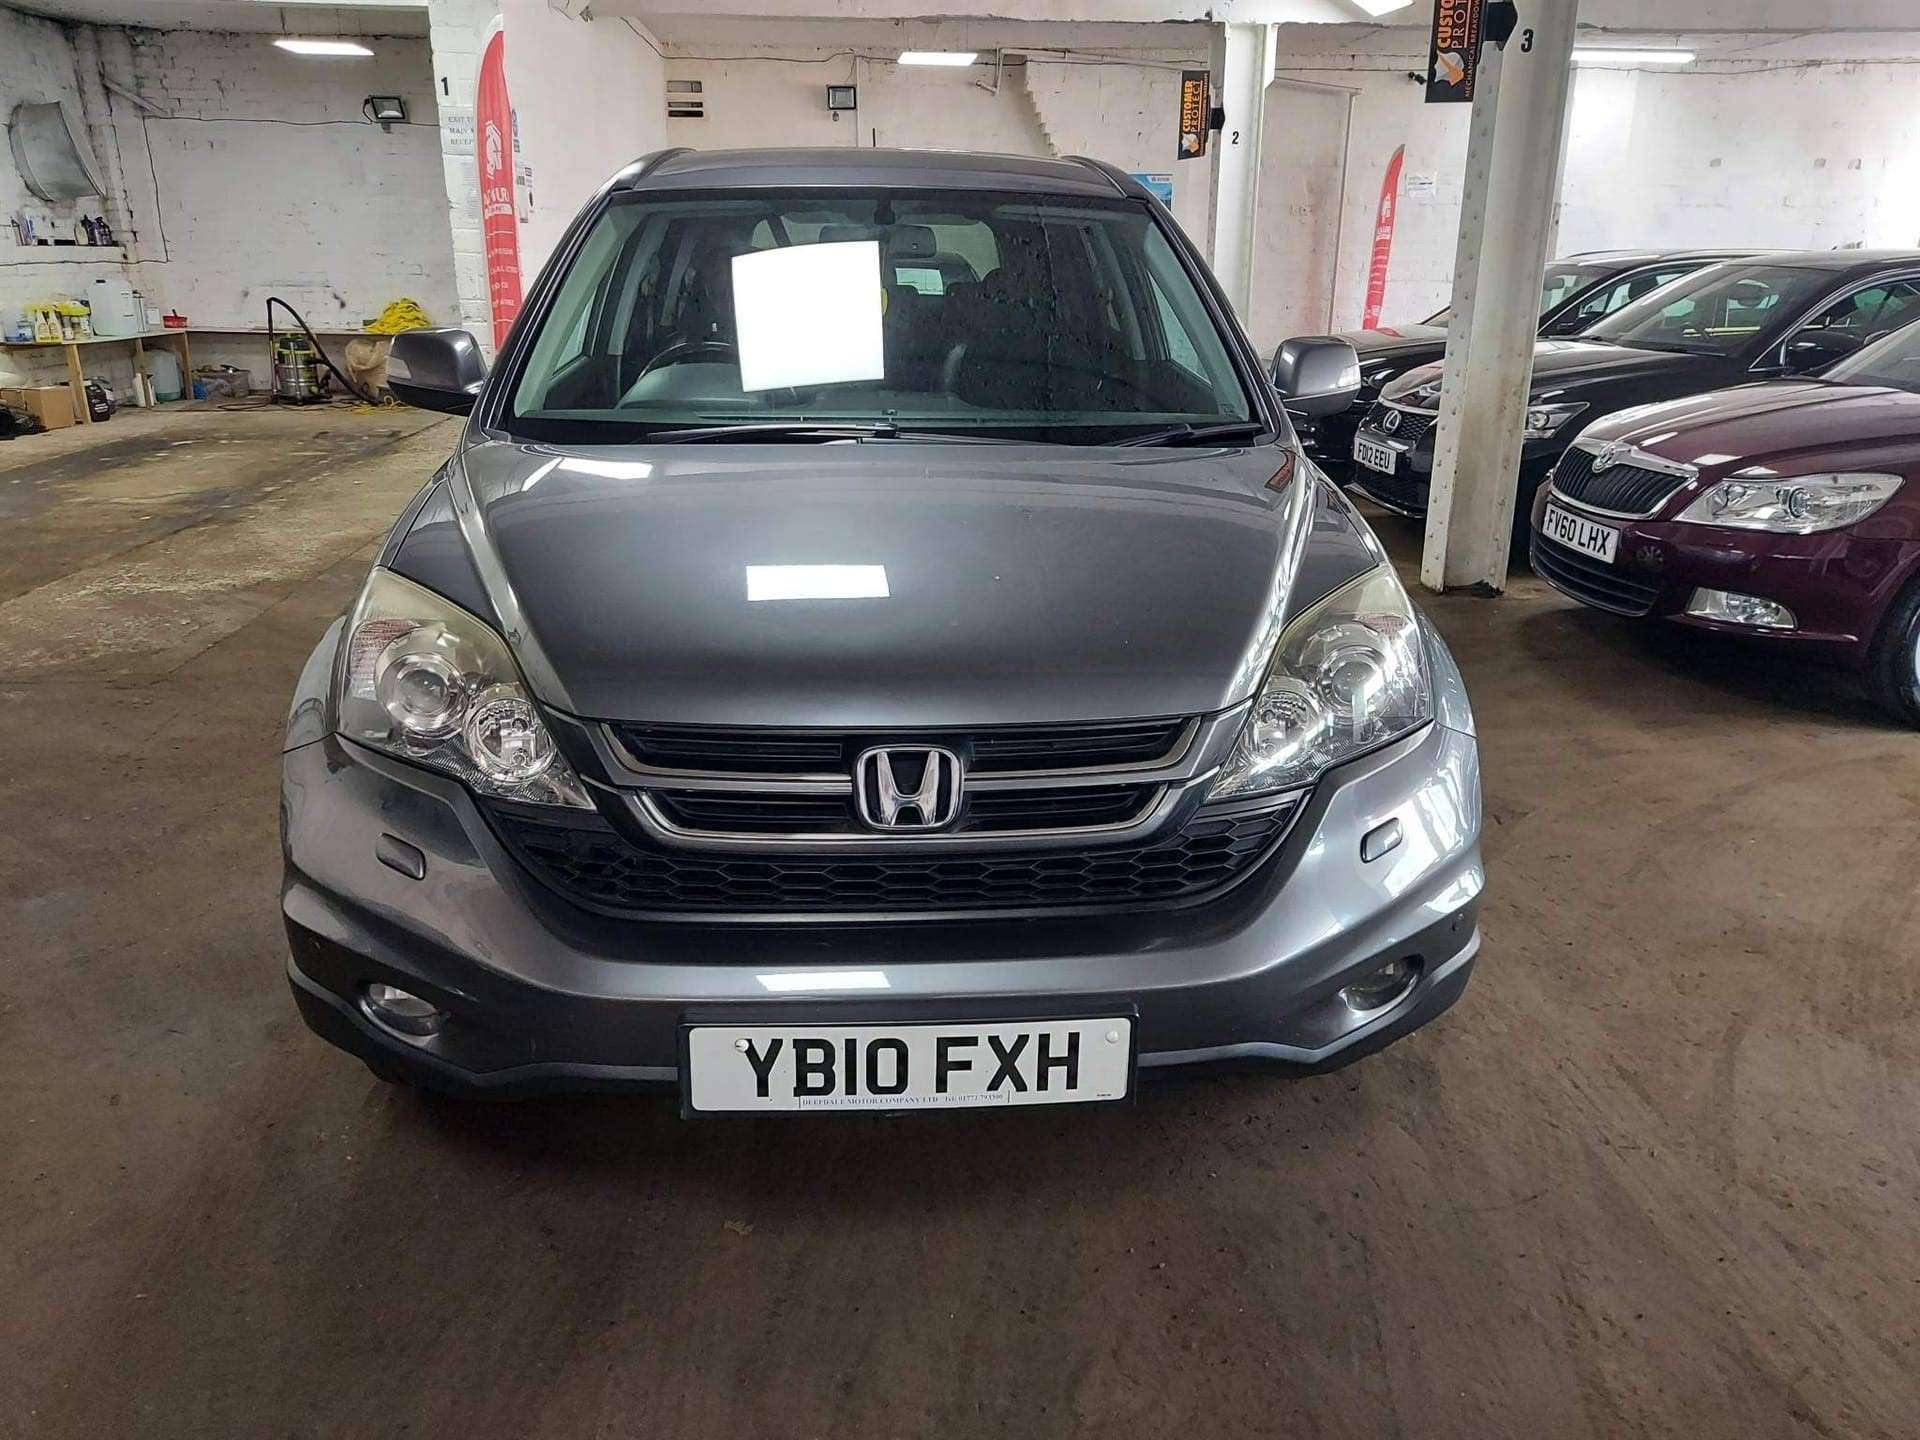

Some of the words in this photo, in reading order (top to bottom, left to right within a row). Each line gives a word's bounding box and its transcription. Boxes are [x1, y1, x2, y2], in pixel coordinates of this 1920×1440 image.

[1521, 28, 1534, 53] 3
[441, 77, 449, 96] 1
[1182, 80, 1193, 132] CUSTOMER
[1191, 80, 1201, 133] PROTECT
[1231, 131, 1240, 145] 2
[1374, 448, 1391, 469] EEU
[1577, 522, 1610, 556] LHX
[744, 1037, 909, 1098] YB10
[935, 1031, 1081, 1096] FXH
[847, 1097, 880, 1105] MOTOR
[880, 1096, 920, 1104] COMPANY
[922, 1096, 939, 1104] LTD
